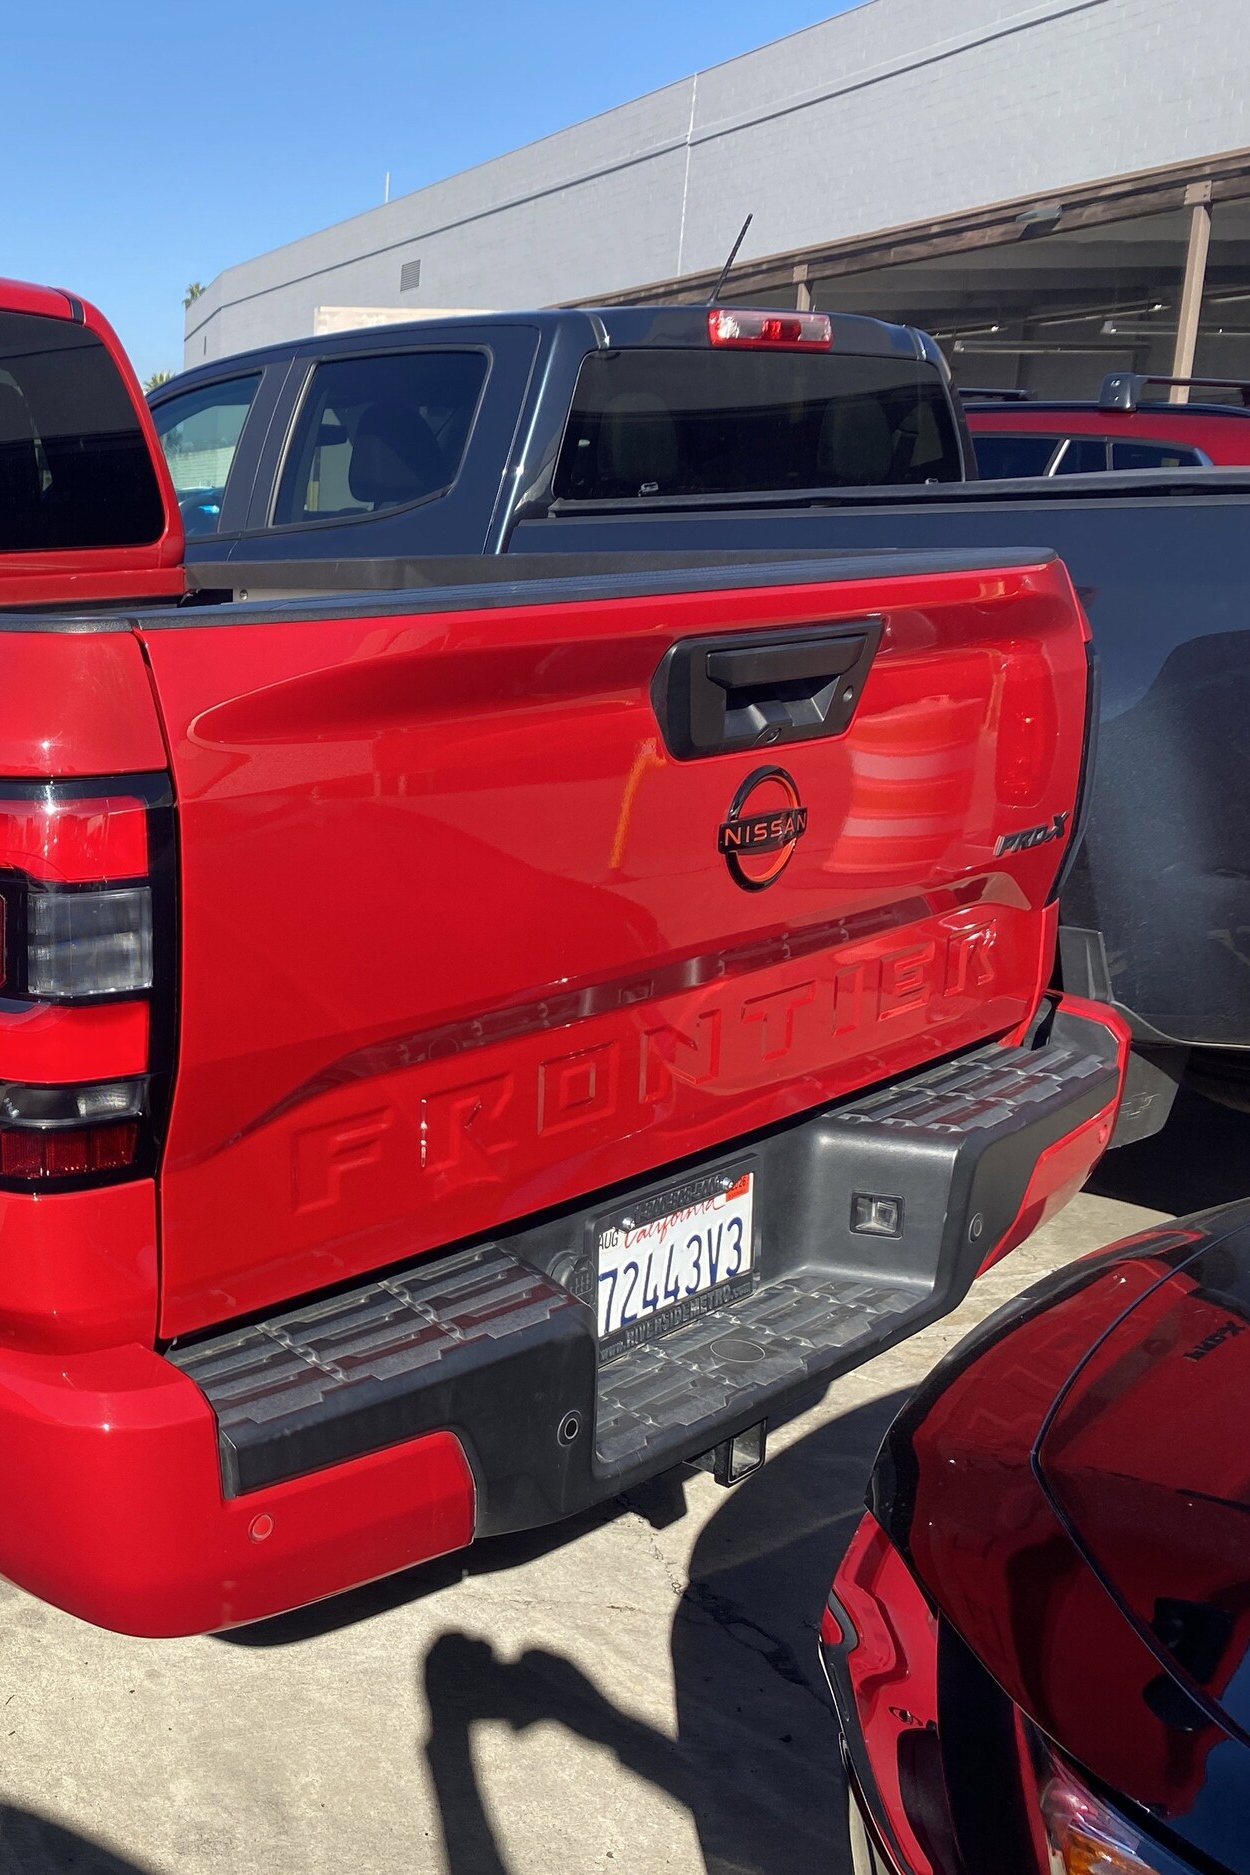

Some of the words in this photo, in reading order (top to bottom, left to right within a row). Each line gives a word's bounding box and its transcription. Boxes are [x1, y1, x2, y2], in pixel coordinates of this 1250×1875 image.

[724, 808, 808, 847] NISSAN
[292, 918, 998, 1215] FRONTIER
[599, 1230, 619, 1250] AUG
[624, 1198, 726, 1249] California
[597, 1216, 743, 1333] 72443V3
